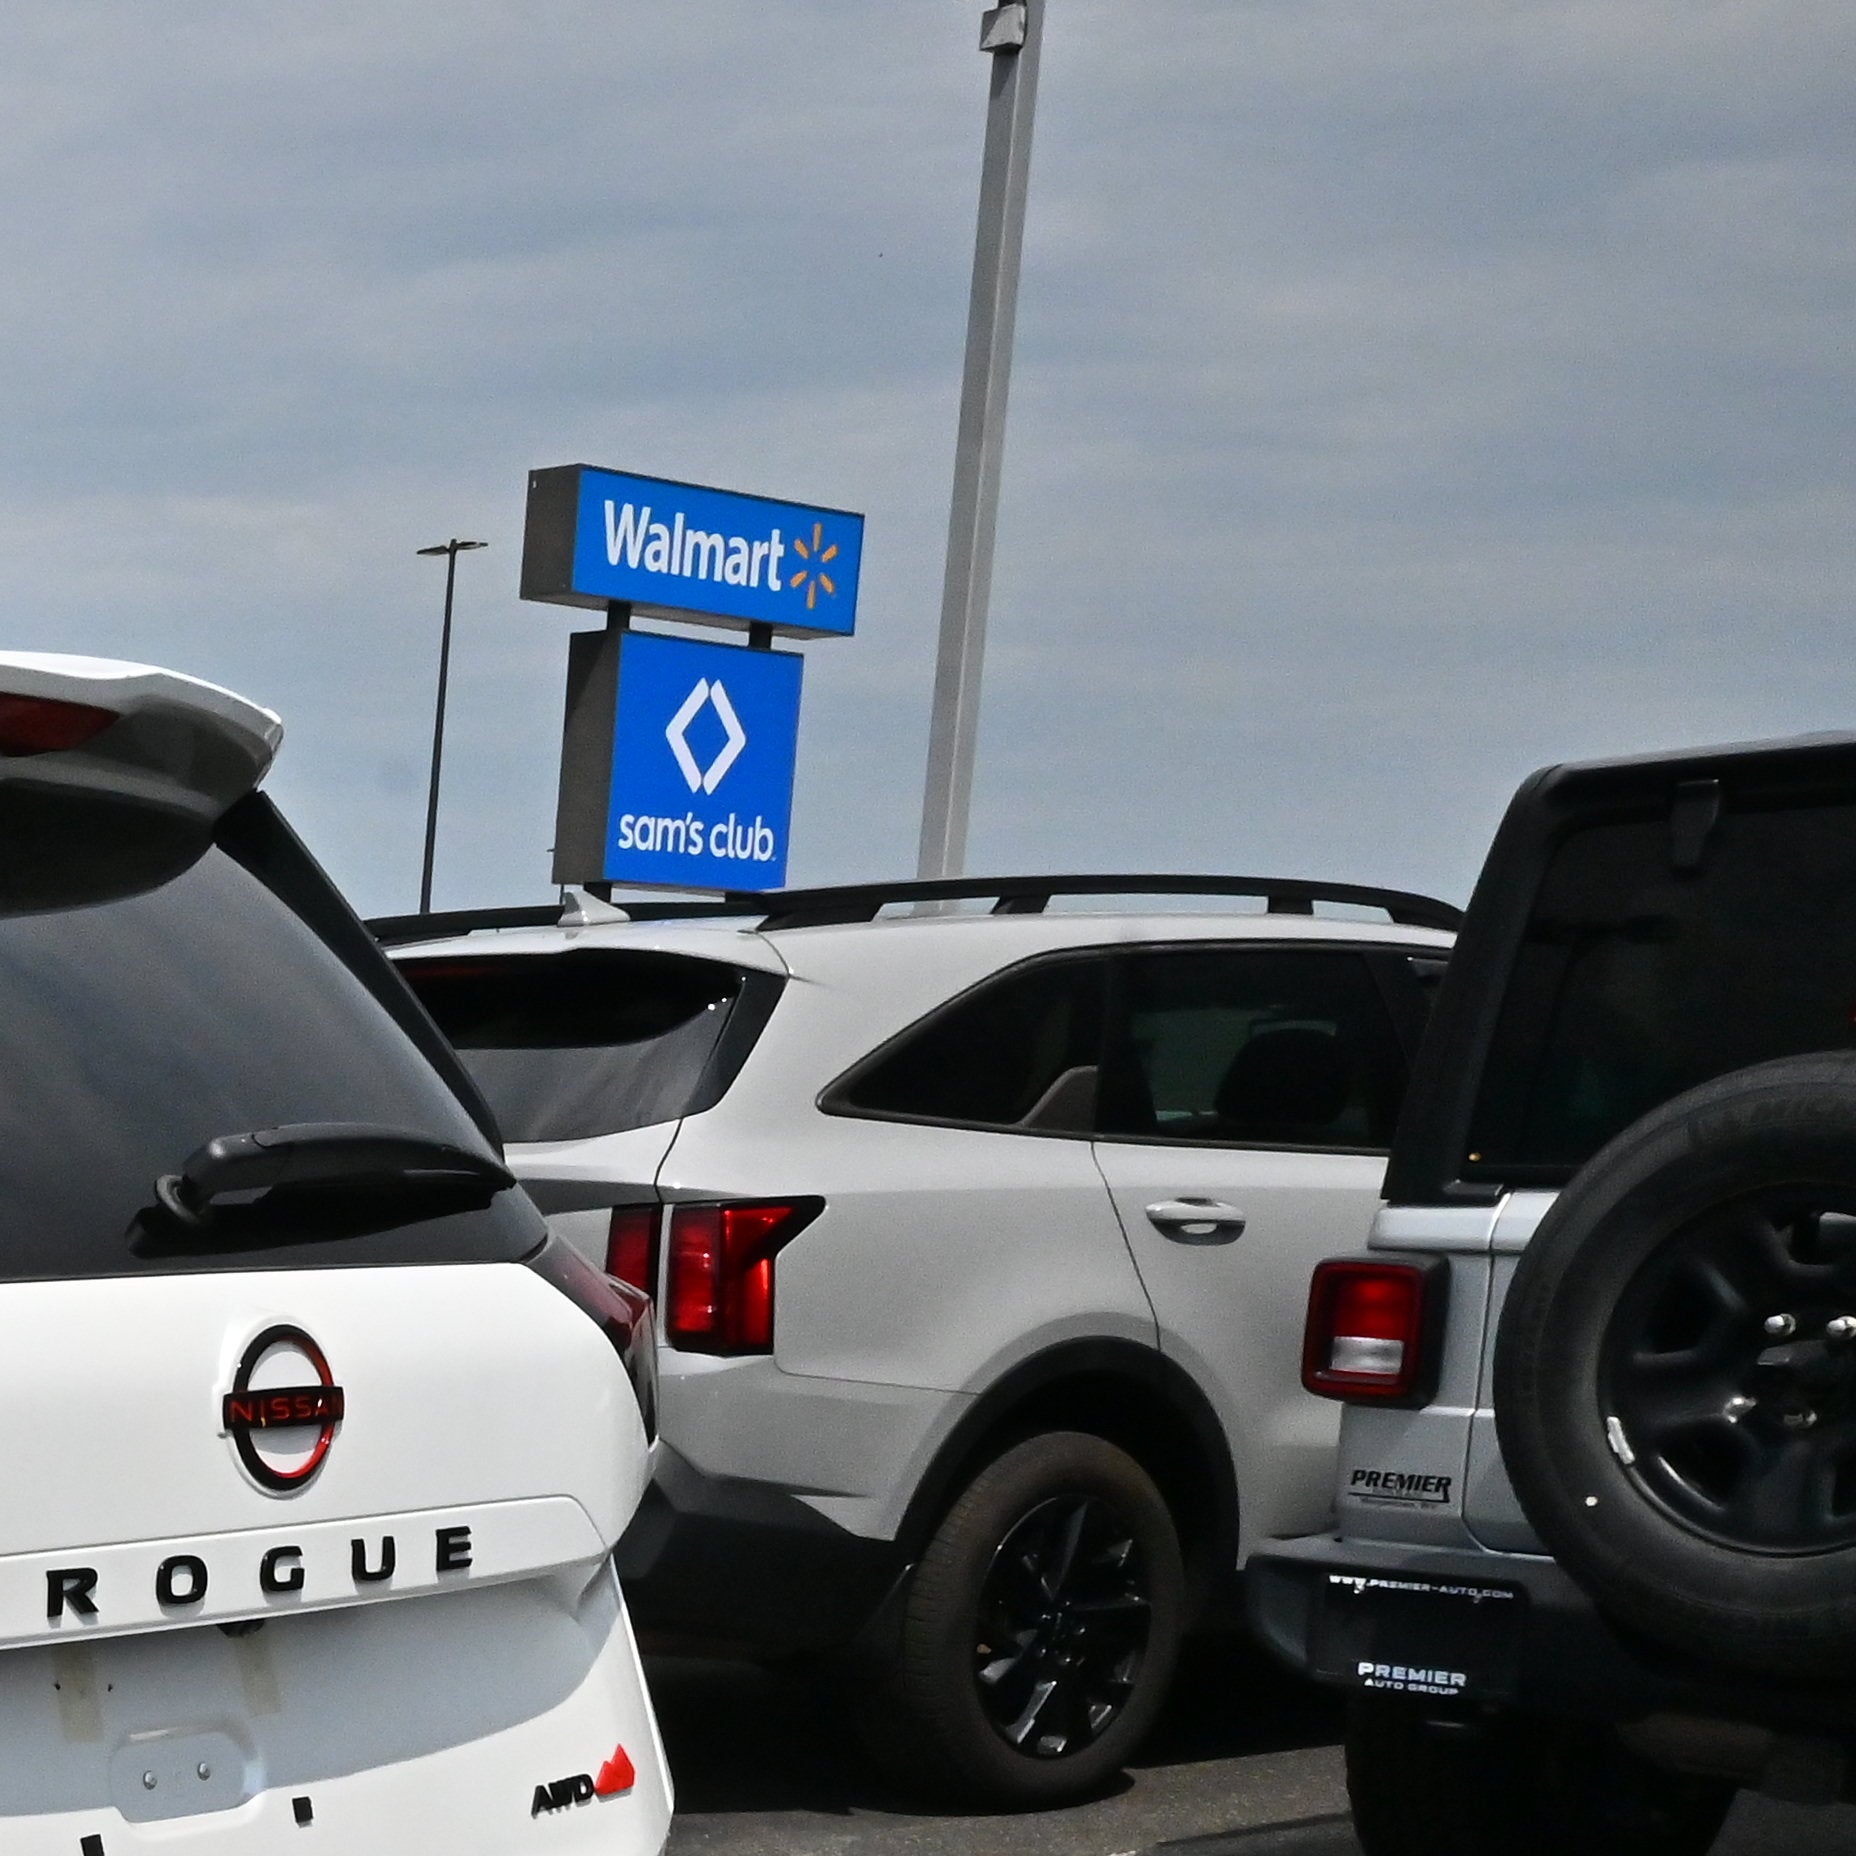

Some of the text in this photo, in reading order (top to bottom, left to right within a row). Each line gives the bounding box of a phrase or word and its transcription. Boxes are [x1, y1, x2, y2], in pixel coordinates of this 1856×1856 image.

[604, 499, 785, 591] Walmart
[618, 811, 774, 862] sam's club
[1350, 1469, 1452, 1502] PREMIER
[46, 1525, 473, 1618] ROGUE
[1357, 1661, 1467, 1687] PREMIER
[1364, 1678, 1404, 1690] AUTO
[531, 1773, 595, 1818] AWD
